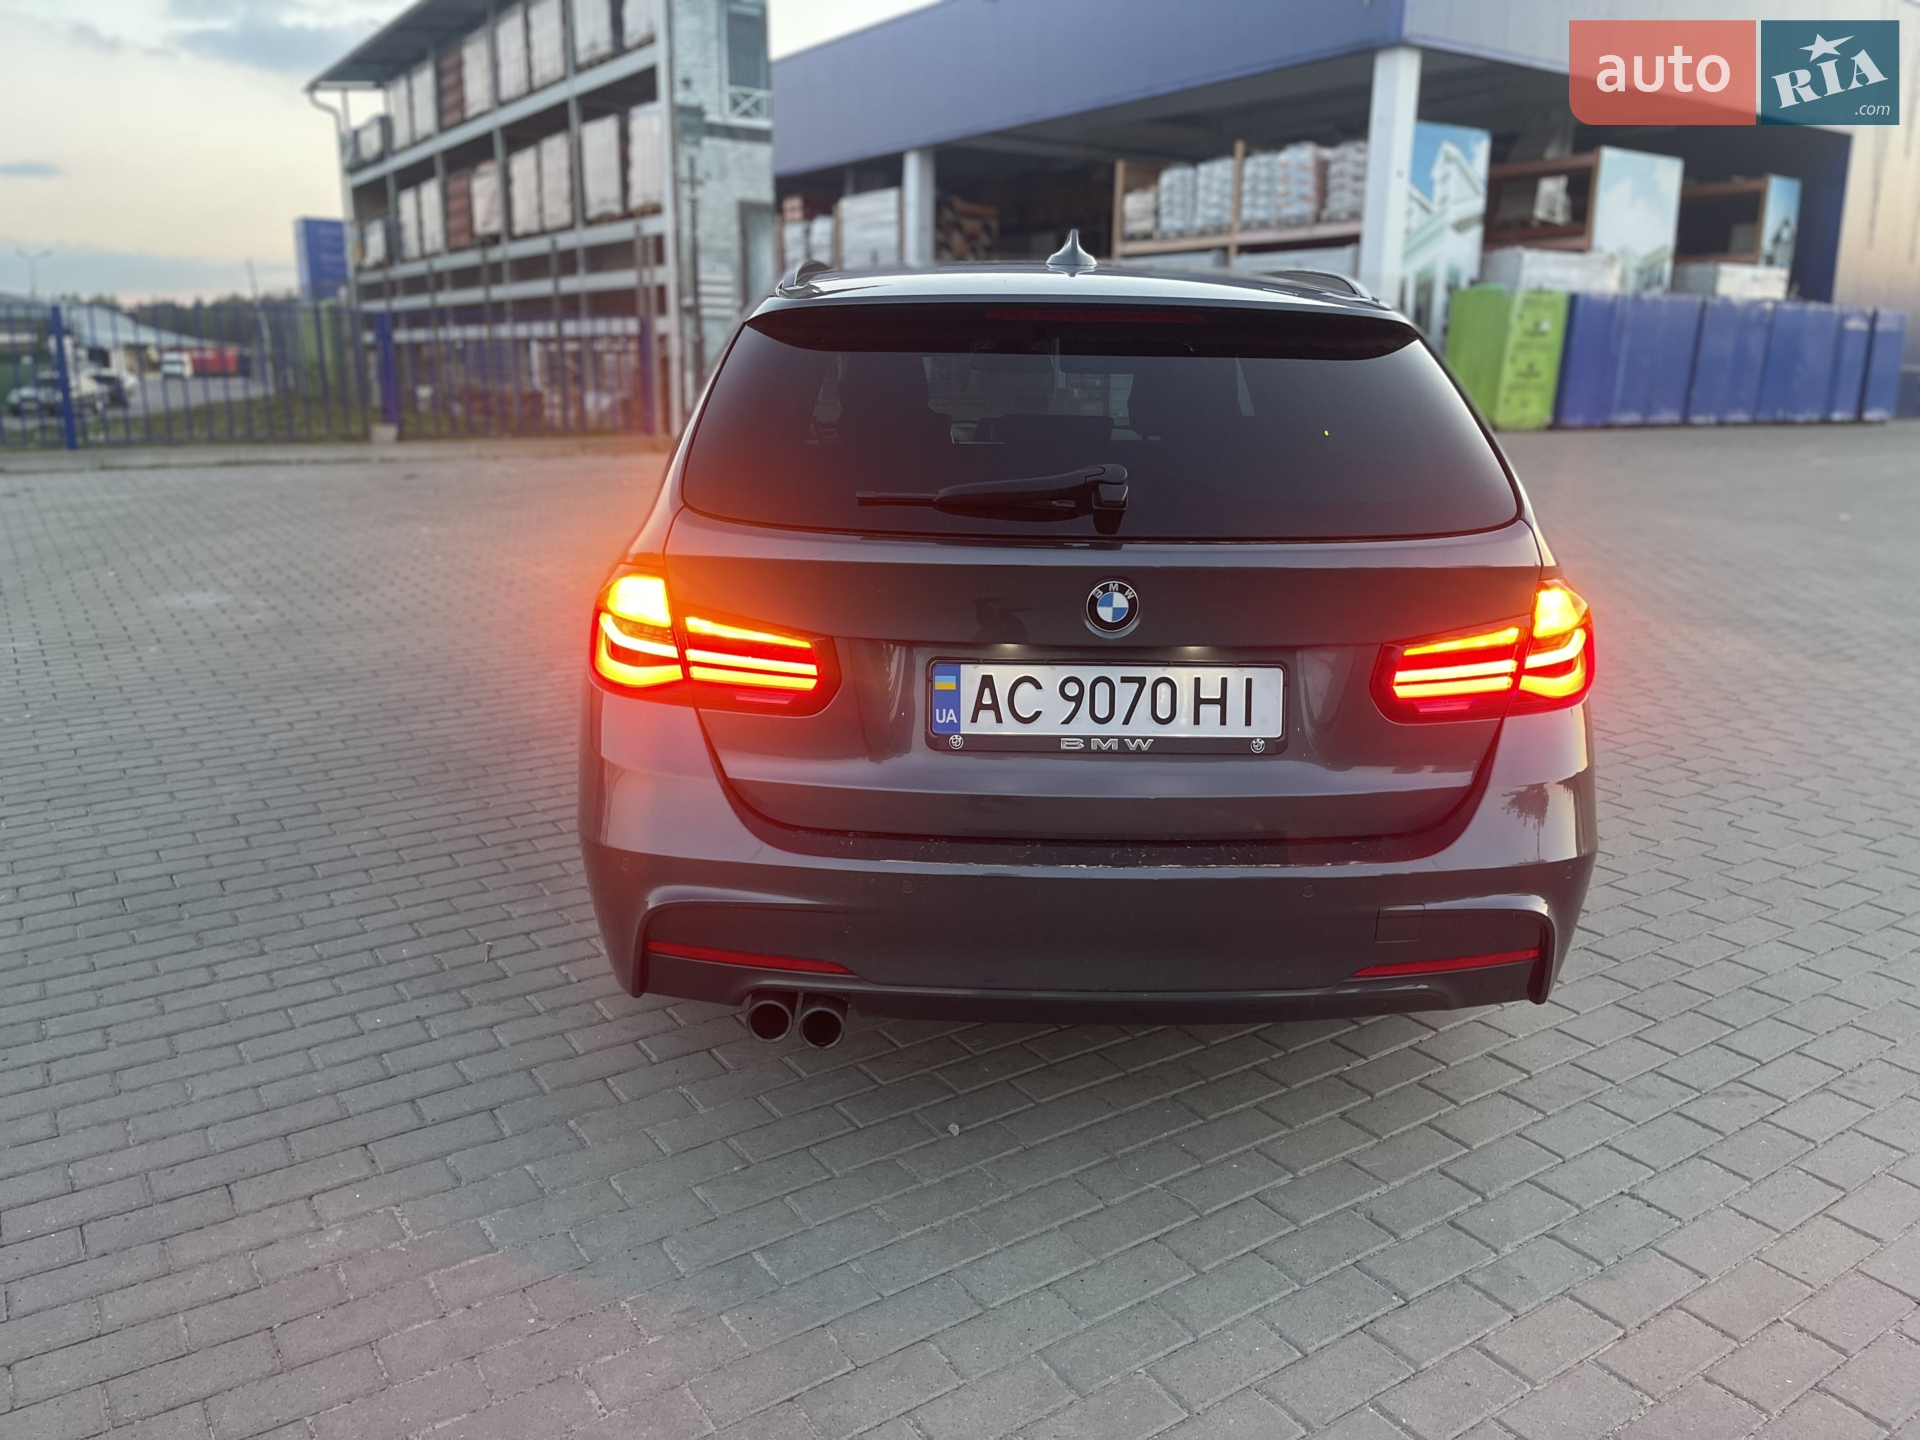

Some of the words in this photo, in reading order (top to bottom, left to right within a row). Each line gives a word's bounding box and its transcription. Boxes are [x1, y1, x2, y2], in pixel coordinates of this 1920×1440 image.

[1092, 583, 1136, 600] BMW
[970, 674, 1043, 724] AC
[1058, 675, 1178, 726] 9070
[1193, 676, 1253, 727] HI
[936, 709, 958, 724] UA
[1060, 737, 1154, 751] BMW
